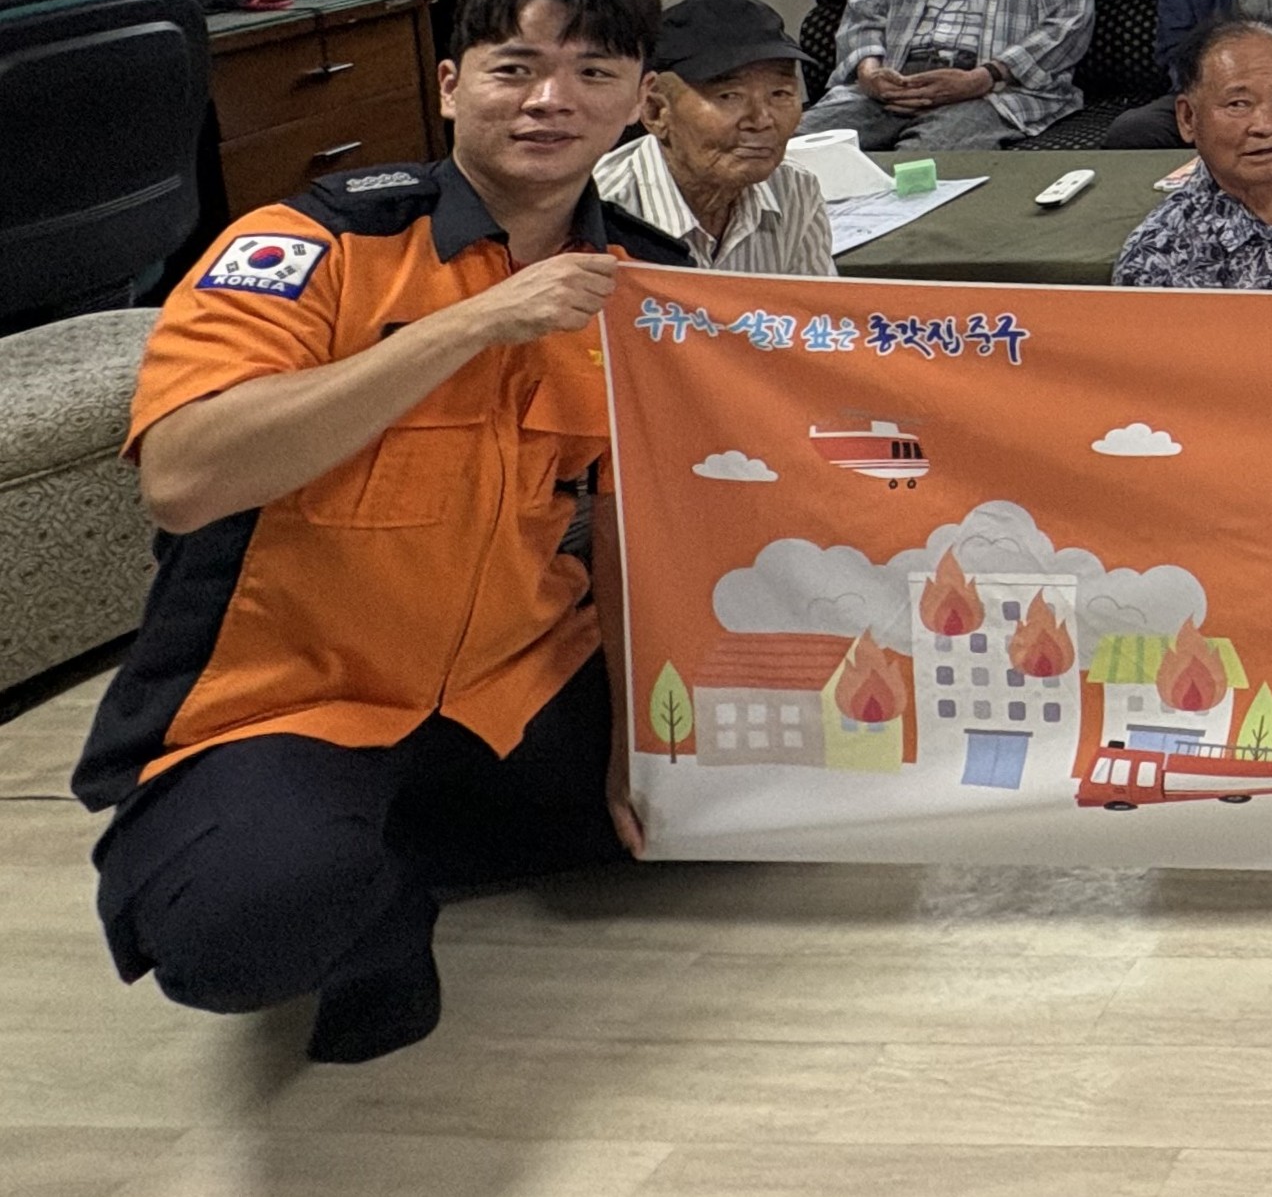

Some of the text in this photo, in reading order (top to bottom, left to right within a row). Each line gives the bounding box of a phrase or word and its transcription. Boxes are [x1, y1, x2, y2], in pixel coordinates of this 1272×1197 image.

[213, 275, 286, 292] KOREA
[634, 297, 1030, 365] 누구나 살고 싶은 종갓집 중구
